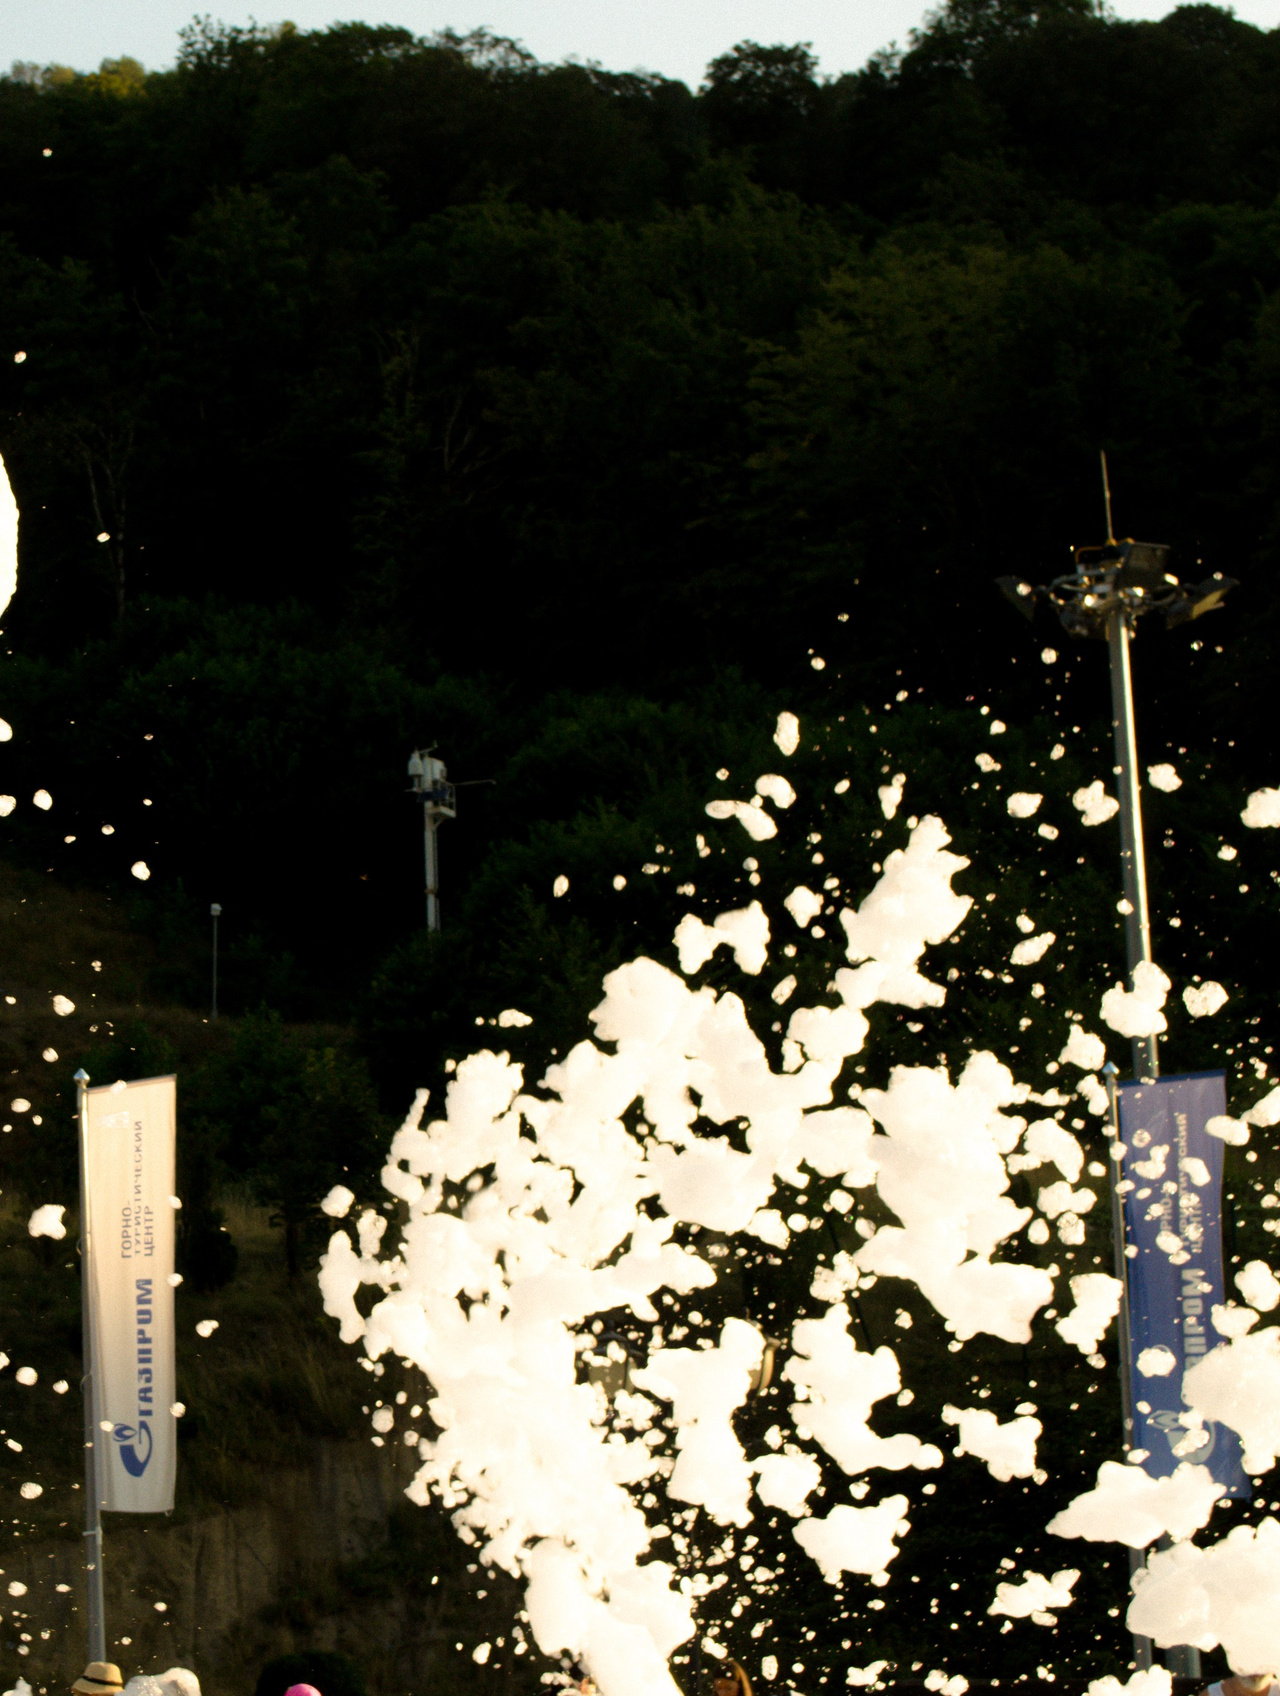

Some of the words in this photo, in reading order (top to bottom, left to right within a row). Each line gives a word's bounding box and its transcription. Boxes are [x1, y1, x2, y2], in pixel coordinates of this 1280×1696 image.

[144, 1205, 154, 1257] ЦЕНТР
[136, 1278, 152, 1417] ГАЗПРОМ
[1182, 1268, 1207, 1371] ПРОМ
